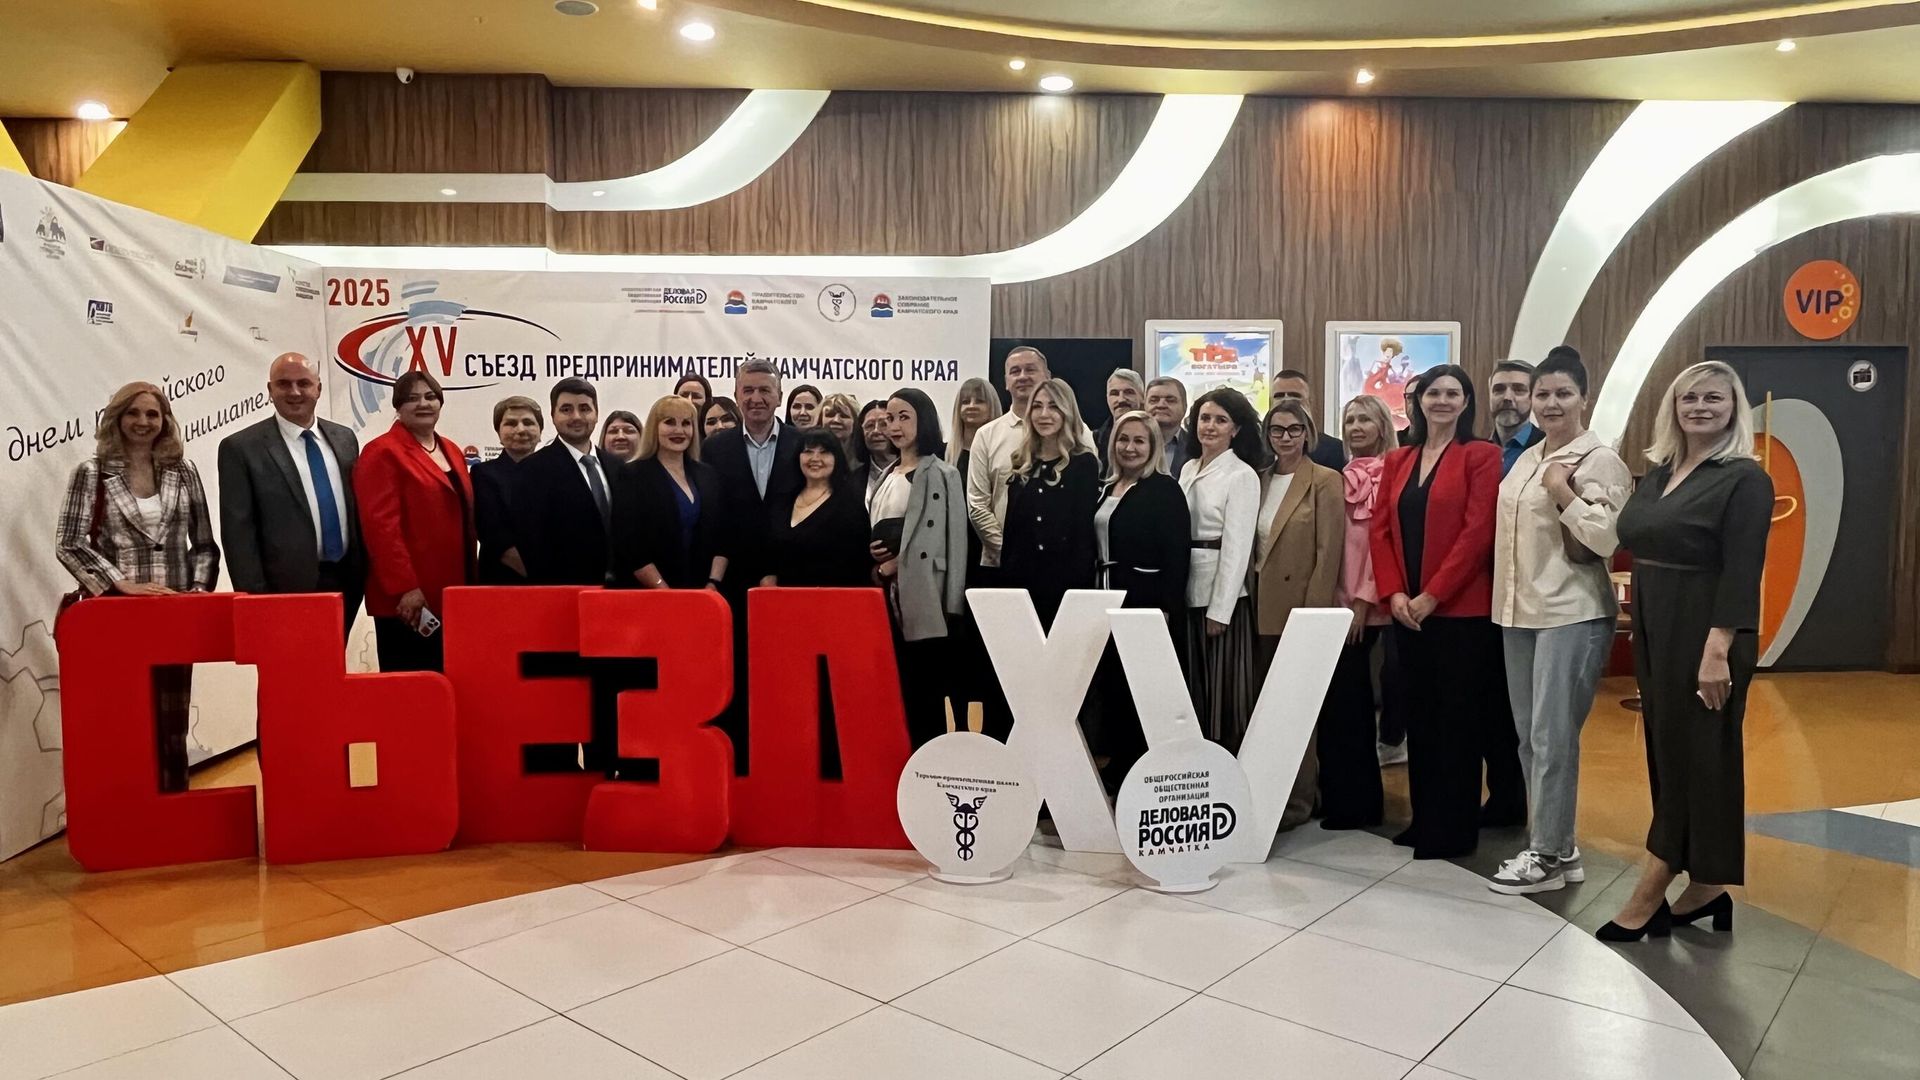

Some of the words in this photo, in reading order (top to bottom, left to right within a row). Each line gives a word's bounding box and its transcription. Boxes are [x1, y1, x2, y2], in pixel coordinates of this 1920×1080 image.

[327, 278, 390, 306] 2025
[664, 295, 695, 304] РОССИЯ
[1796, 288, 1845, 315] VIP
[405, 326, 457, 377] XV
[465, 354, 537, 381] СЪЕЗД
[546, 352, 757, 381] ПРЕДПРИНИМАТЕЛЕ
[766, 357, 904, 380] АМЧАТСКОГО
[911, 359, 959, 381] КРАЯ
[7, 418, 84, 462] днем
[57, 585, 913, 872] СЪЕЗД
[965, 588, 1354, 864] XV
[1144, 771, 1210, 784] ОБЩЕРОССИЙСКАЯ
[1154, 781, 1210, 793] ОБЩЕСТВЕННАЯ
[1158, 792, 1210, 803] ОРГАНИЗАЦИЯ
[1139, 804, 1210, 828] ДЕЛОВАЯ
[1139, 822, 1210, 848] РОССИЯ
[1139, 843, 1210, 857] КАМЧАТКА
